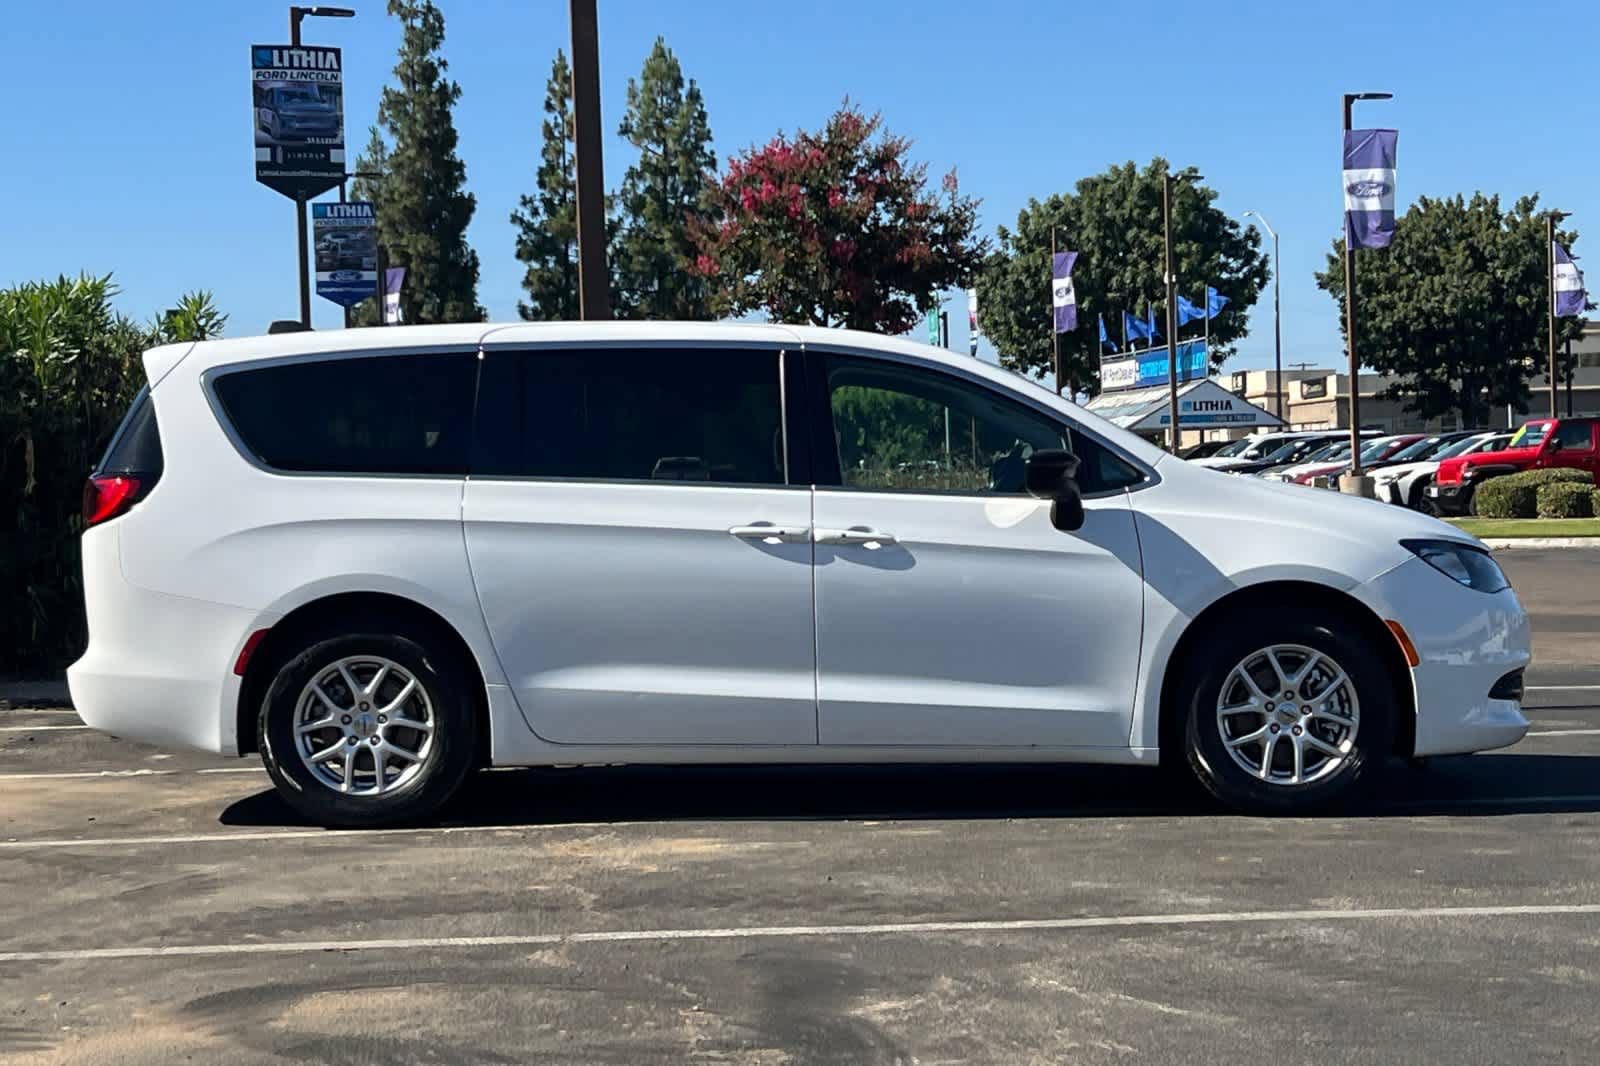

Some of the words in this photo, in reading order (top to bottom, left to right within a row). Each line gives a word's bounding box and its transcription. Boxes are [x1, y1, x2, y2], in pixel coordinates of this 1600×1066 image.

[272, 49, 339, 69] LITHIA
[256, 71, 288, 80] FORD
[290, 71, 338, 81] LINCOLN
[327, 204, 373, 217] LITHIA
[1193, 400, 1233, 412] LITHIA
